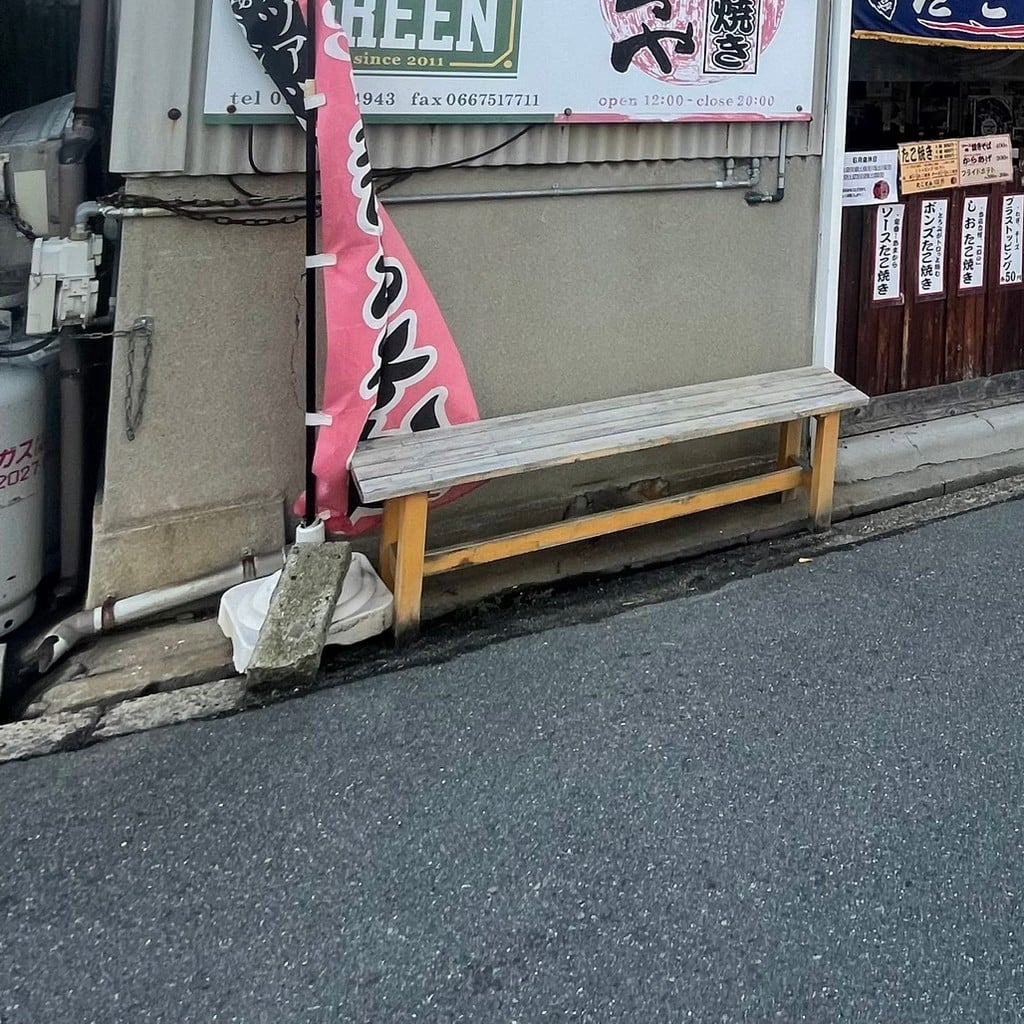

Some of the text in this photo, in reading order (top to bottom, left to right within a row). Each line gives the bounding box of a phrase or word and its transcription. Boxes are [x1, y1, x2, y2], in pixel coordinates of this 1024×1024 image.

[352, 51, 444, 67] since 2011
[229, 90, 261, 106] tel
[411, 91, 442, 106] fax
[446, 93, 539, 107] 0667517711
[599, 96, 638, 109] open
[644, 94, 684, 107] 12:00
[696, 95, 734, 107] close
[737, 96, 775, 107] 20:00
[877, 206, 893, 296] ソースたこ焼き
[962, 200, 977, 285] しおたこ焼き
